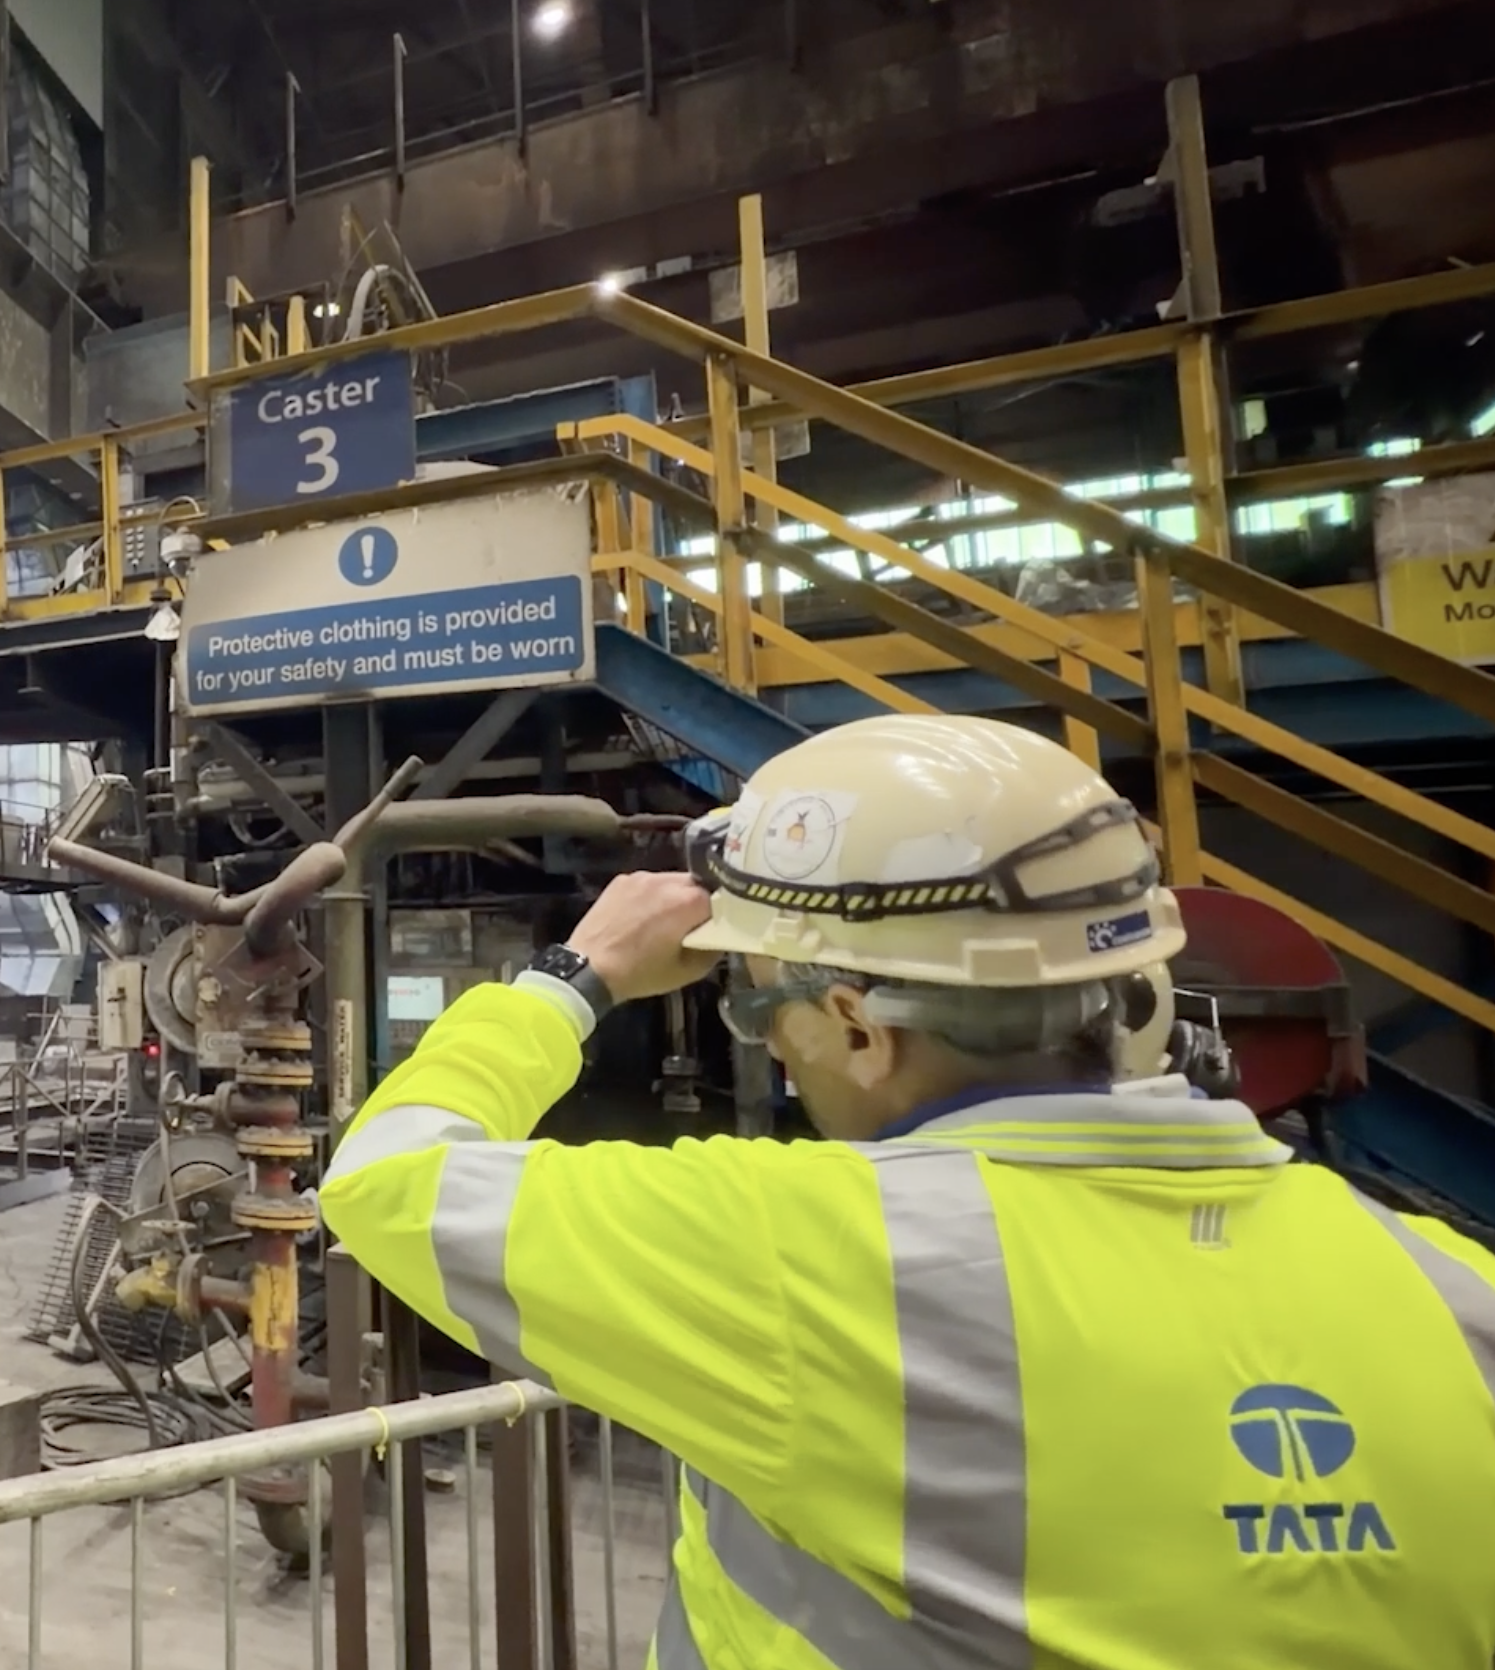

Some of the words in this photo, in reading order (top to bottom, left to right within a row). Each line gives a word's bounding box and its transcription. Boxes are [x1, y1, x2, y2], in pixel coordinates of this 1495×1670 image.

[257, 376, 381, 424] Caster
[296, 425, 339, 494] 3
[1441, 559, 1495, 591] W
[208, 628, 314, 659] Protective
[319, 616, 411, 645] clothing
[417, 610, 438, 634] is
[444, 595, 556, 637] provided
[195, 669, 224, 691] for
[229, 667, 276, 693] your
[280, 656, 346, 683] safety
[353, 648, 396, 676] and
[404, 642, 464, 671] must
[471, 640, 503, 664] be
[509, 635, 575, 660] worn
[1222, 1501, 1398, 1554] TATA
